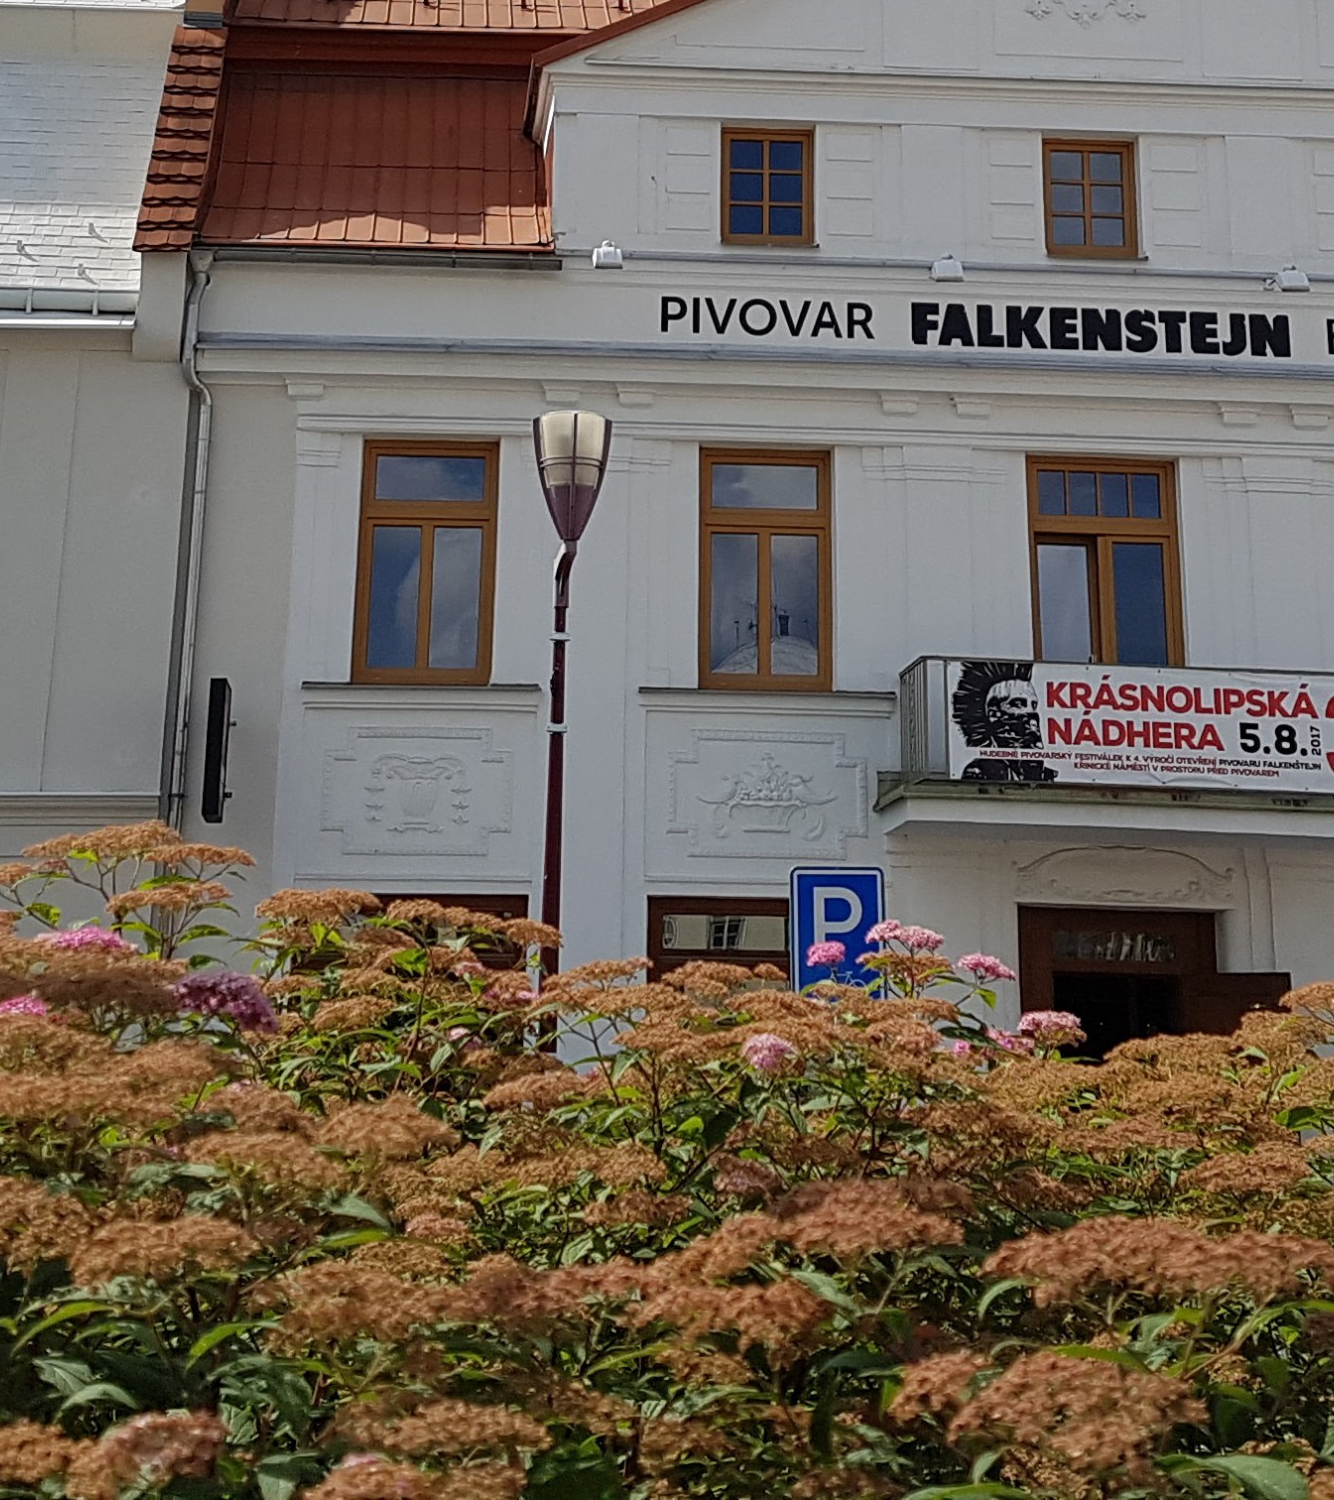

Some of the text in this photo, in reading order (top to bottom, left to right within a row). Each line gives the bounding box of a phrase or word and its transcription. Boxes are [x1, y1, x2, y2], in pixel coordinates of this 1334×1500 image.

[659, 295, 876, 340] PIVOVAR
[910, 300, 1293, 359] FALKENSTEJN
[1045, 674, 1320, 720] KRÁSNOLIPSKÁ
[1046, 709, 1309, 757] NÁDHERA 5.8.
[1309, 724, 1323, 757] 2017
[812, 886, 864, 947] P
